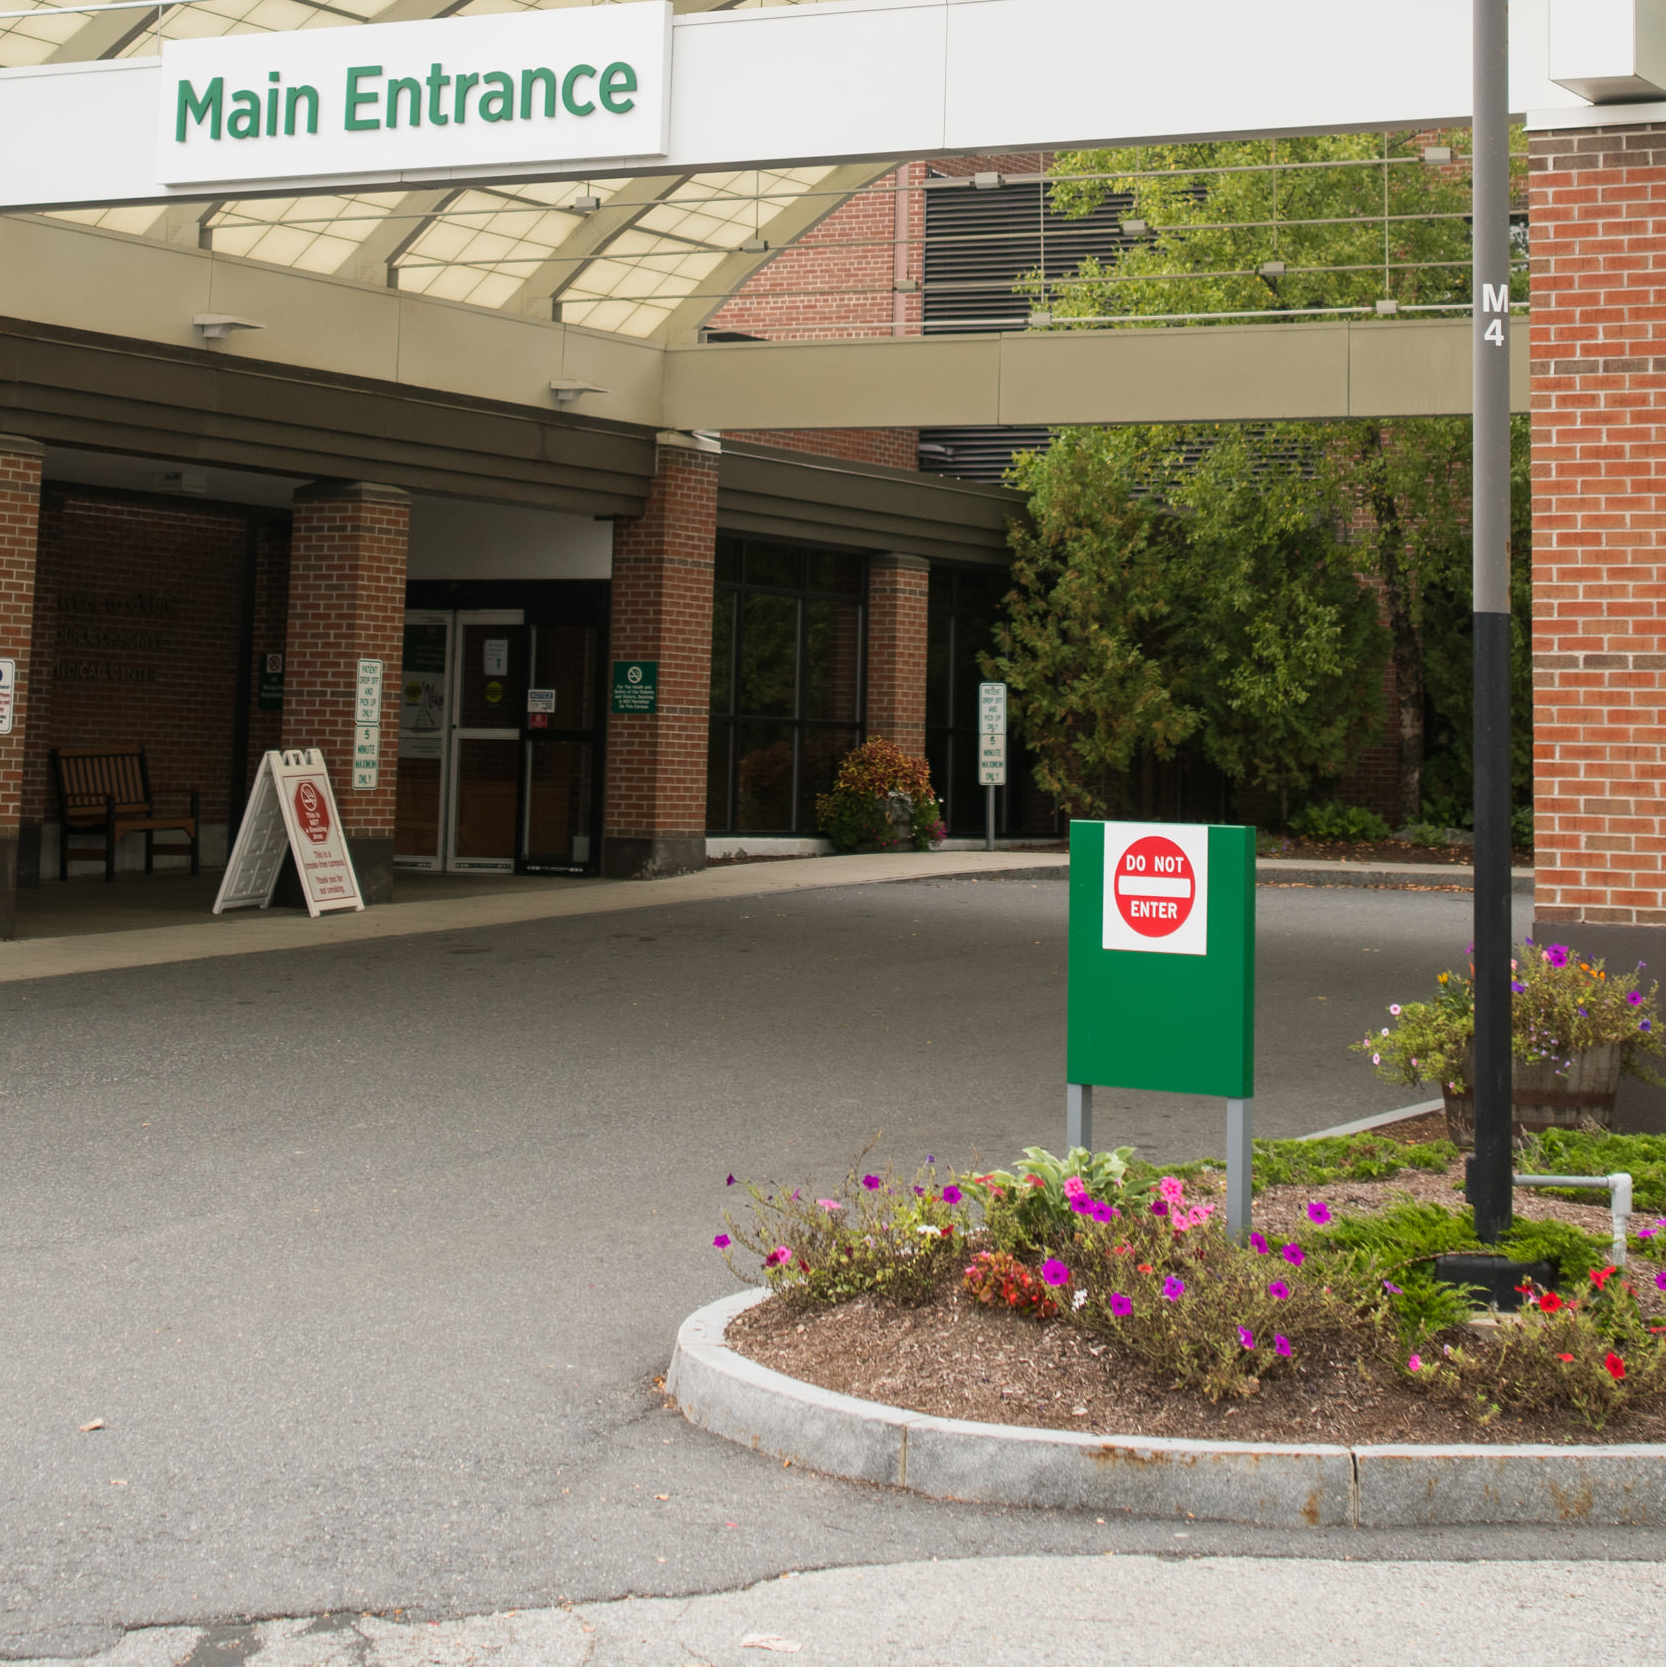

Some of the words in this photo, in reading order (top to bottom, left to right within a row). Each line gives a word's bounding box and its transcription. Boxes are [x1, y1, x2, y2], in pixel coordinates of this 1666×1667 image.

[175, 71, 319, 142] Main
[344, 61, 637, 132] Entrance
[1482, 284, 1509, 313] M
[1484, 318, 1505, 346] 4
[362, 665, 378, 674] PATIENT
[359, 676, 370, 684] DROP
[364, 687, 373, 696] AND
[360, 698, 369, 706] PICK
[362, 709, 373, 718] ONLY
[364, 729, 370, 740] 5
[358, 745, 376, 754] MINUTE
[356, 760, 376, 769] MAXIMUM
[358, 774, 372, 784] ONLY
[1126, 854, 1146, 872] DO
[1154, 856, 1184, 873] NOT
[1130, 900, 1178, 919] ENTER
